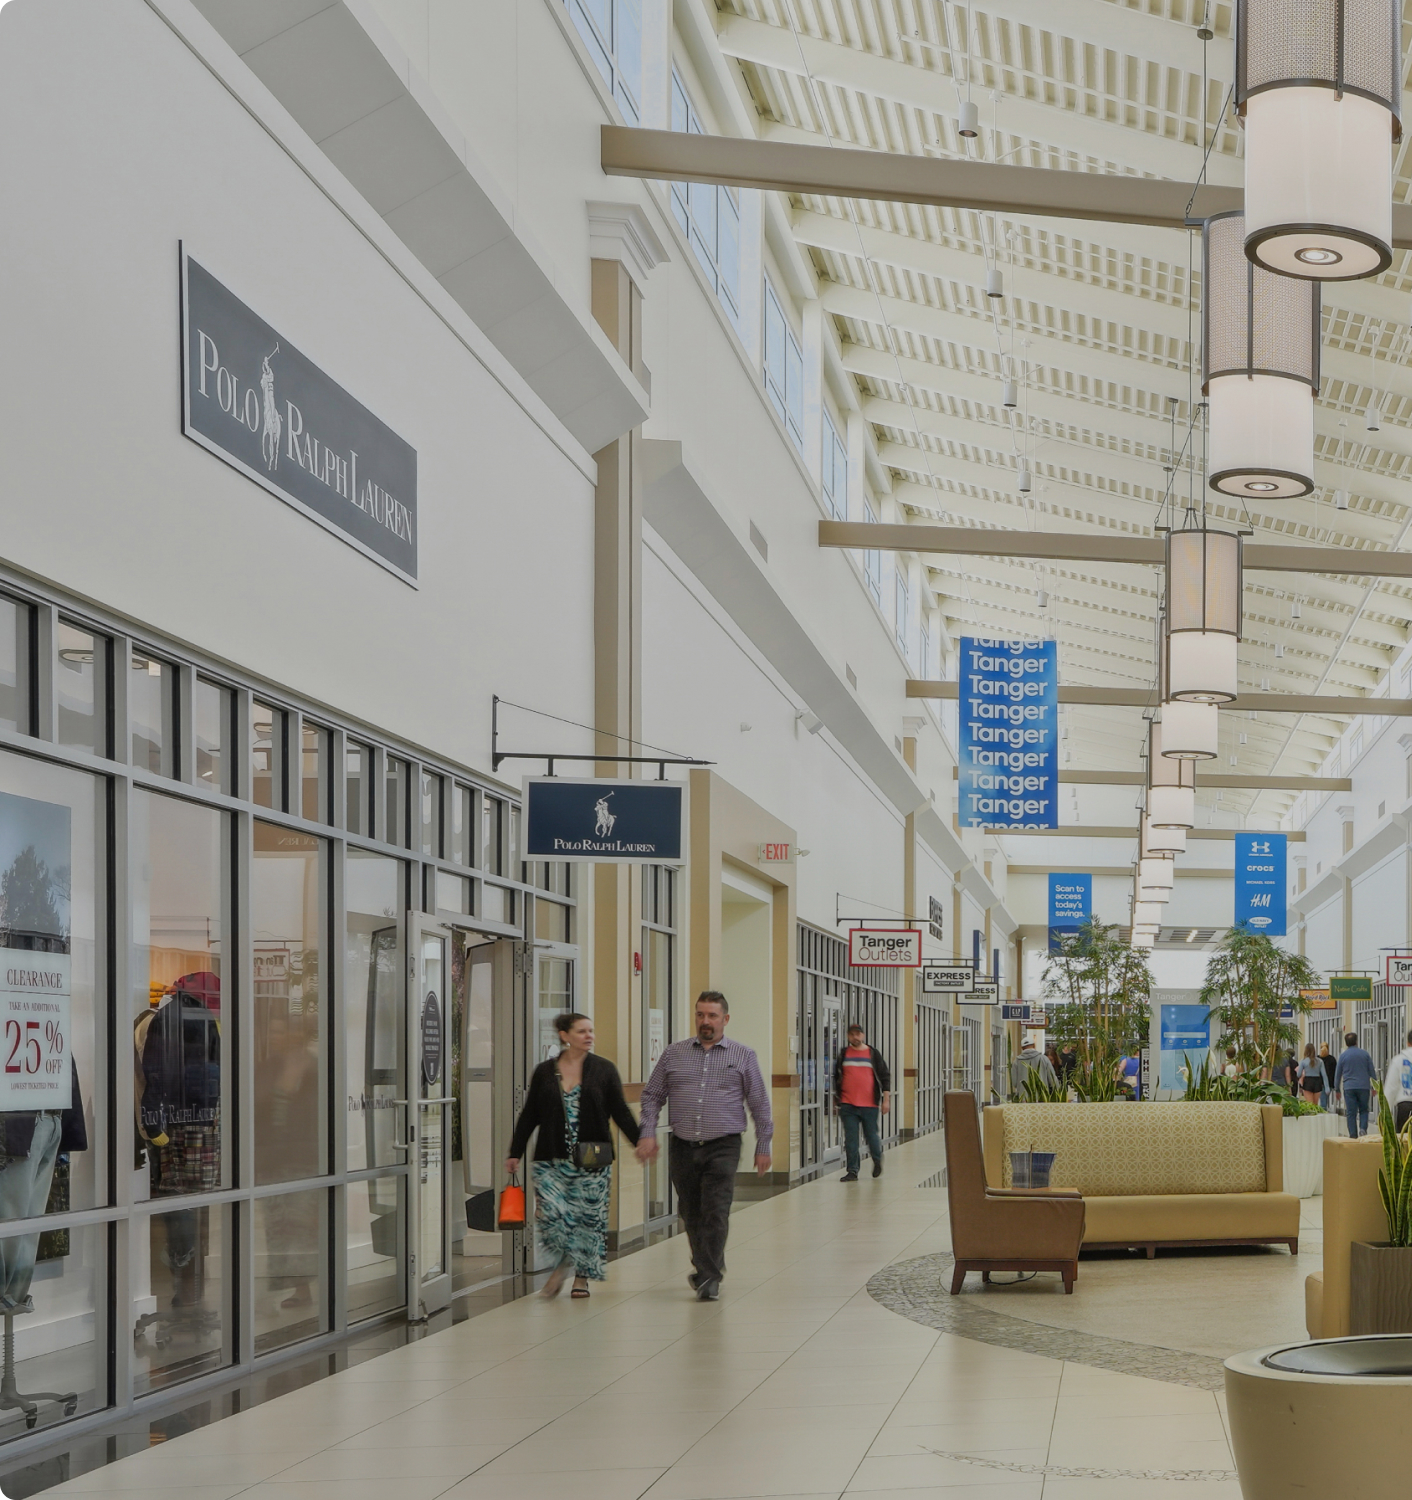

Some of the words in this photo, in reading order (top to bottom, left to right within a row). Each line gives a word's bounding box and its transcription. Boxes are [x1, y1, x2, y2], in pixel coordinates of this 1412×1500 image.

[197, 329, 260, 432] POLO
[285, 399, 348, 499] RALPH
[350, 449, 413, 545] LAUREN
[968, 651, 1048, 678] Tanger
[968, 674, 1048, 701] Tanger
[968, 698, 1049, 725] Tanger
[968, 722, 1049, 748] Tanger
[967, 746, 1049, 772] Tanger
[967, 770, 1049, 796] Tanger
[967, 794, 1049, 819] Tanger
[554, 838, 581, 850] POLO
[582, 839, 615, 851] RALPH
[617, 840, 655, 852] LAUREN
[766, 844, 789, 860] EXIT
[1055, 901, 1082, 909] today's
[1250, 894, 1271, 907] H&M
[1055, 910, 1085, 919] savings.
[859, 935, 912, 950] Tanger
[858, 947, 912, 961] Outlets
[7, 969, 62, 988] CLEARANCE
[926, 972, 971, 980] EXPRESS
[1351, 985, 1368, 993] Crafts
[9, 1002, 21, 1011] TAKE
[23, 1002, 30, 1011] AN
[31, 1003, 61, 1012] ADDITIONAL
[5, 1019, 63, 1074] 25%
[45, 1059, 63, 1074] OFF
[10, 1082, 27, 1090] LOWEST
